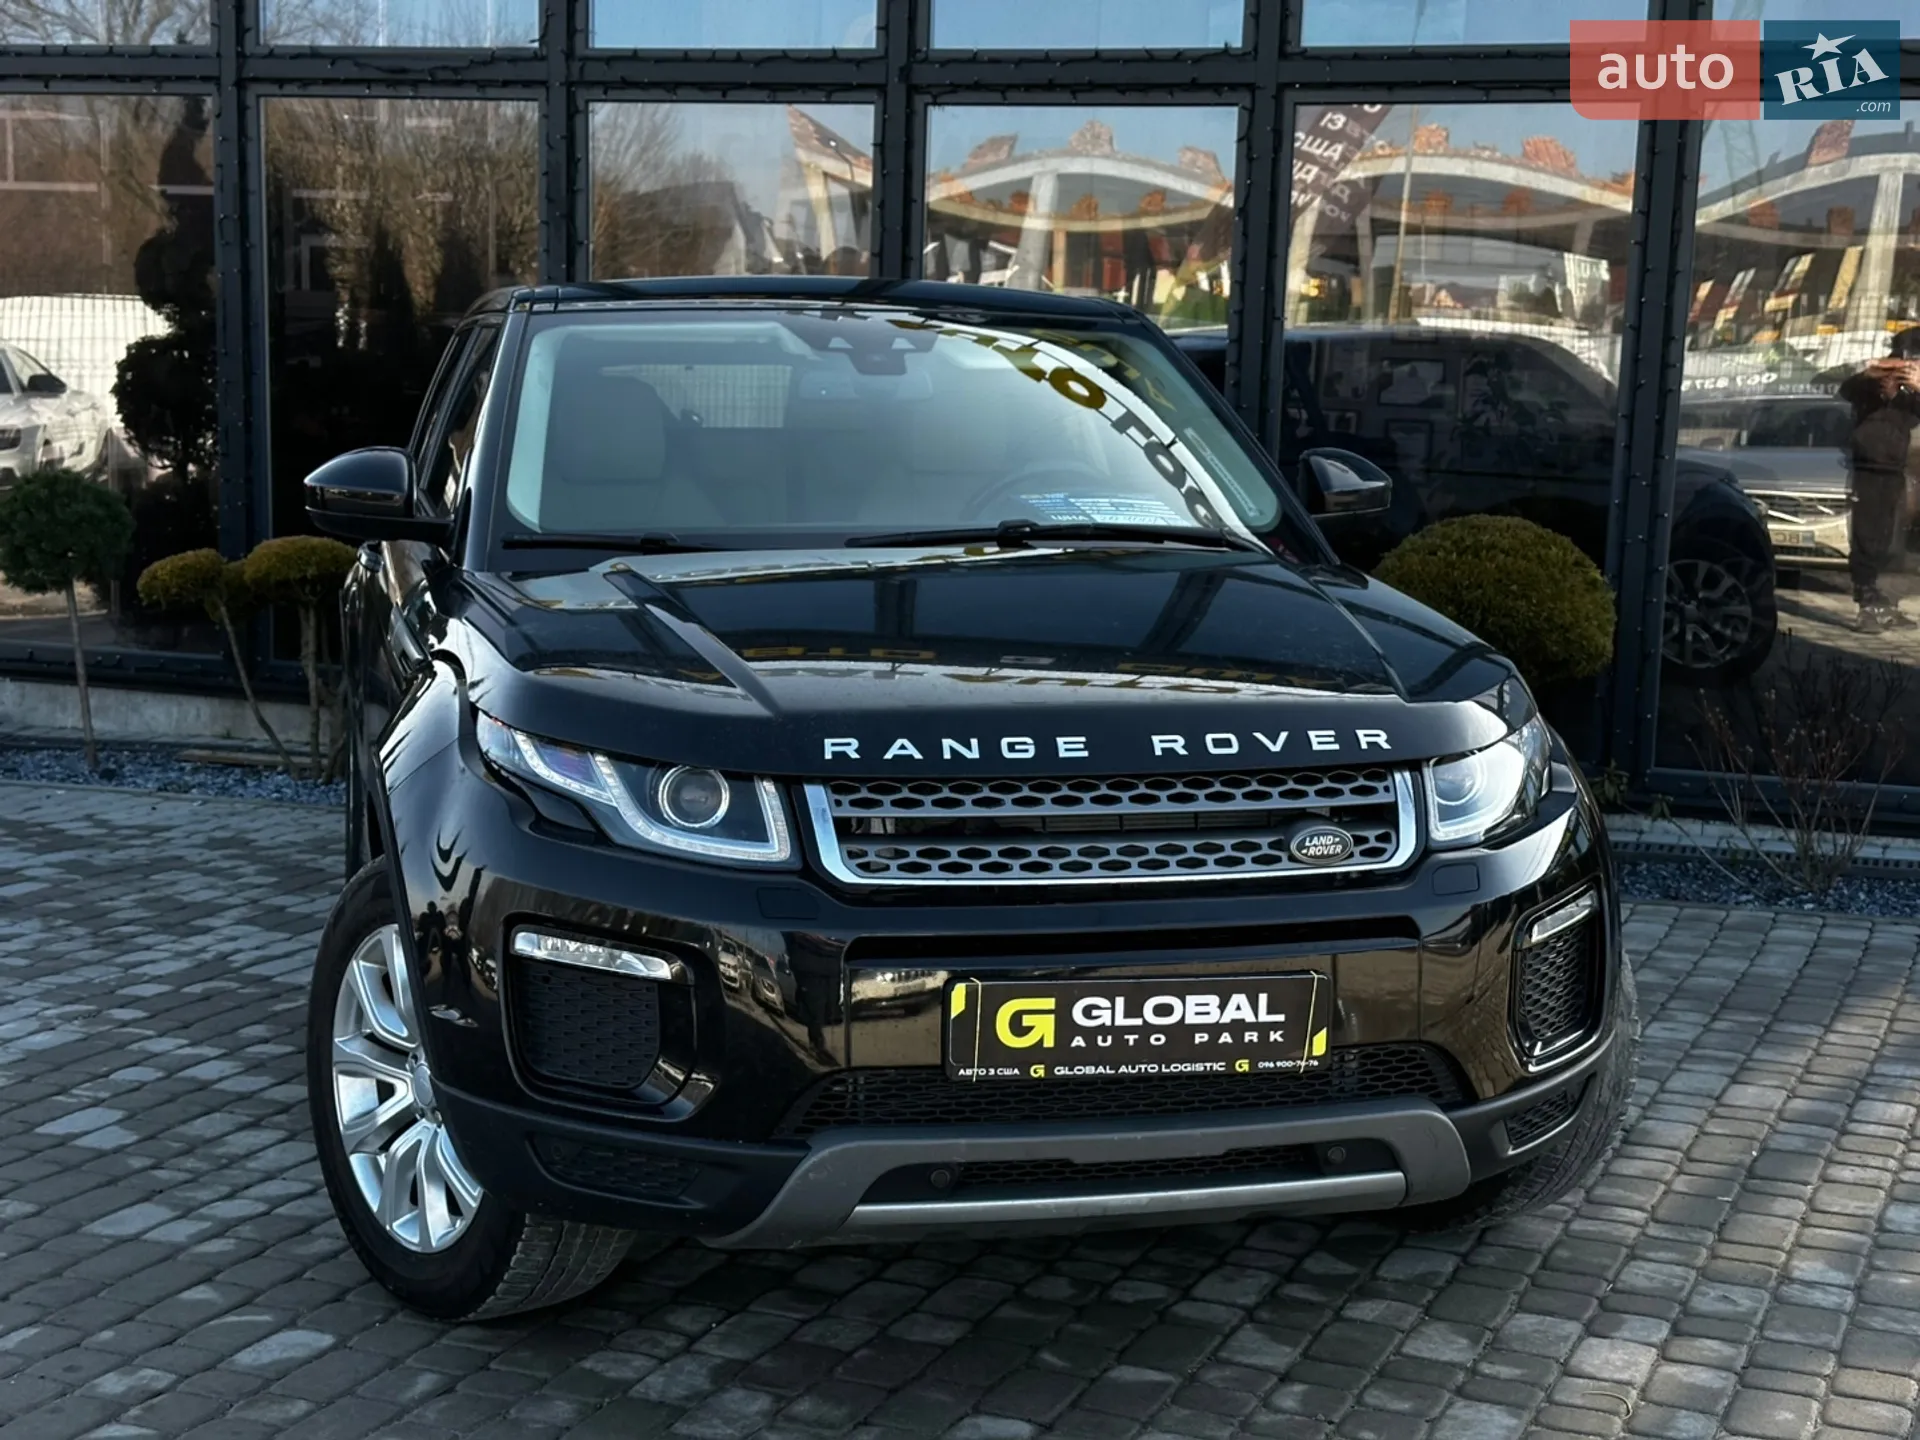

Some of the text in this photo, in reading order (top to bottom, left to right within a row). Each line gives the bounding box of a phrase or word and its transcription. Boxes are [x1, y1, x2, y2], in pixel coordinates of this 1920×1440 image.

[824, 729, 1392, 760] RANGE ROVER
[1072, 993, 1285, 1027] GLOBAL
[1070, 1030, 1285, 1047] AUTO PARK
[996, 1067, 1020, 1075] США
[1054, 1065, 1115, 1075] GLOBAL
[1118, 1063, 1158, 1073] AUTO
[1161, 1062, 1226, 1072] LOGISTIC
